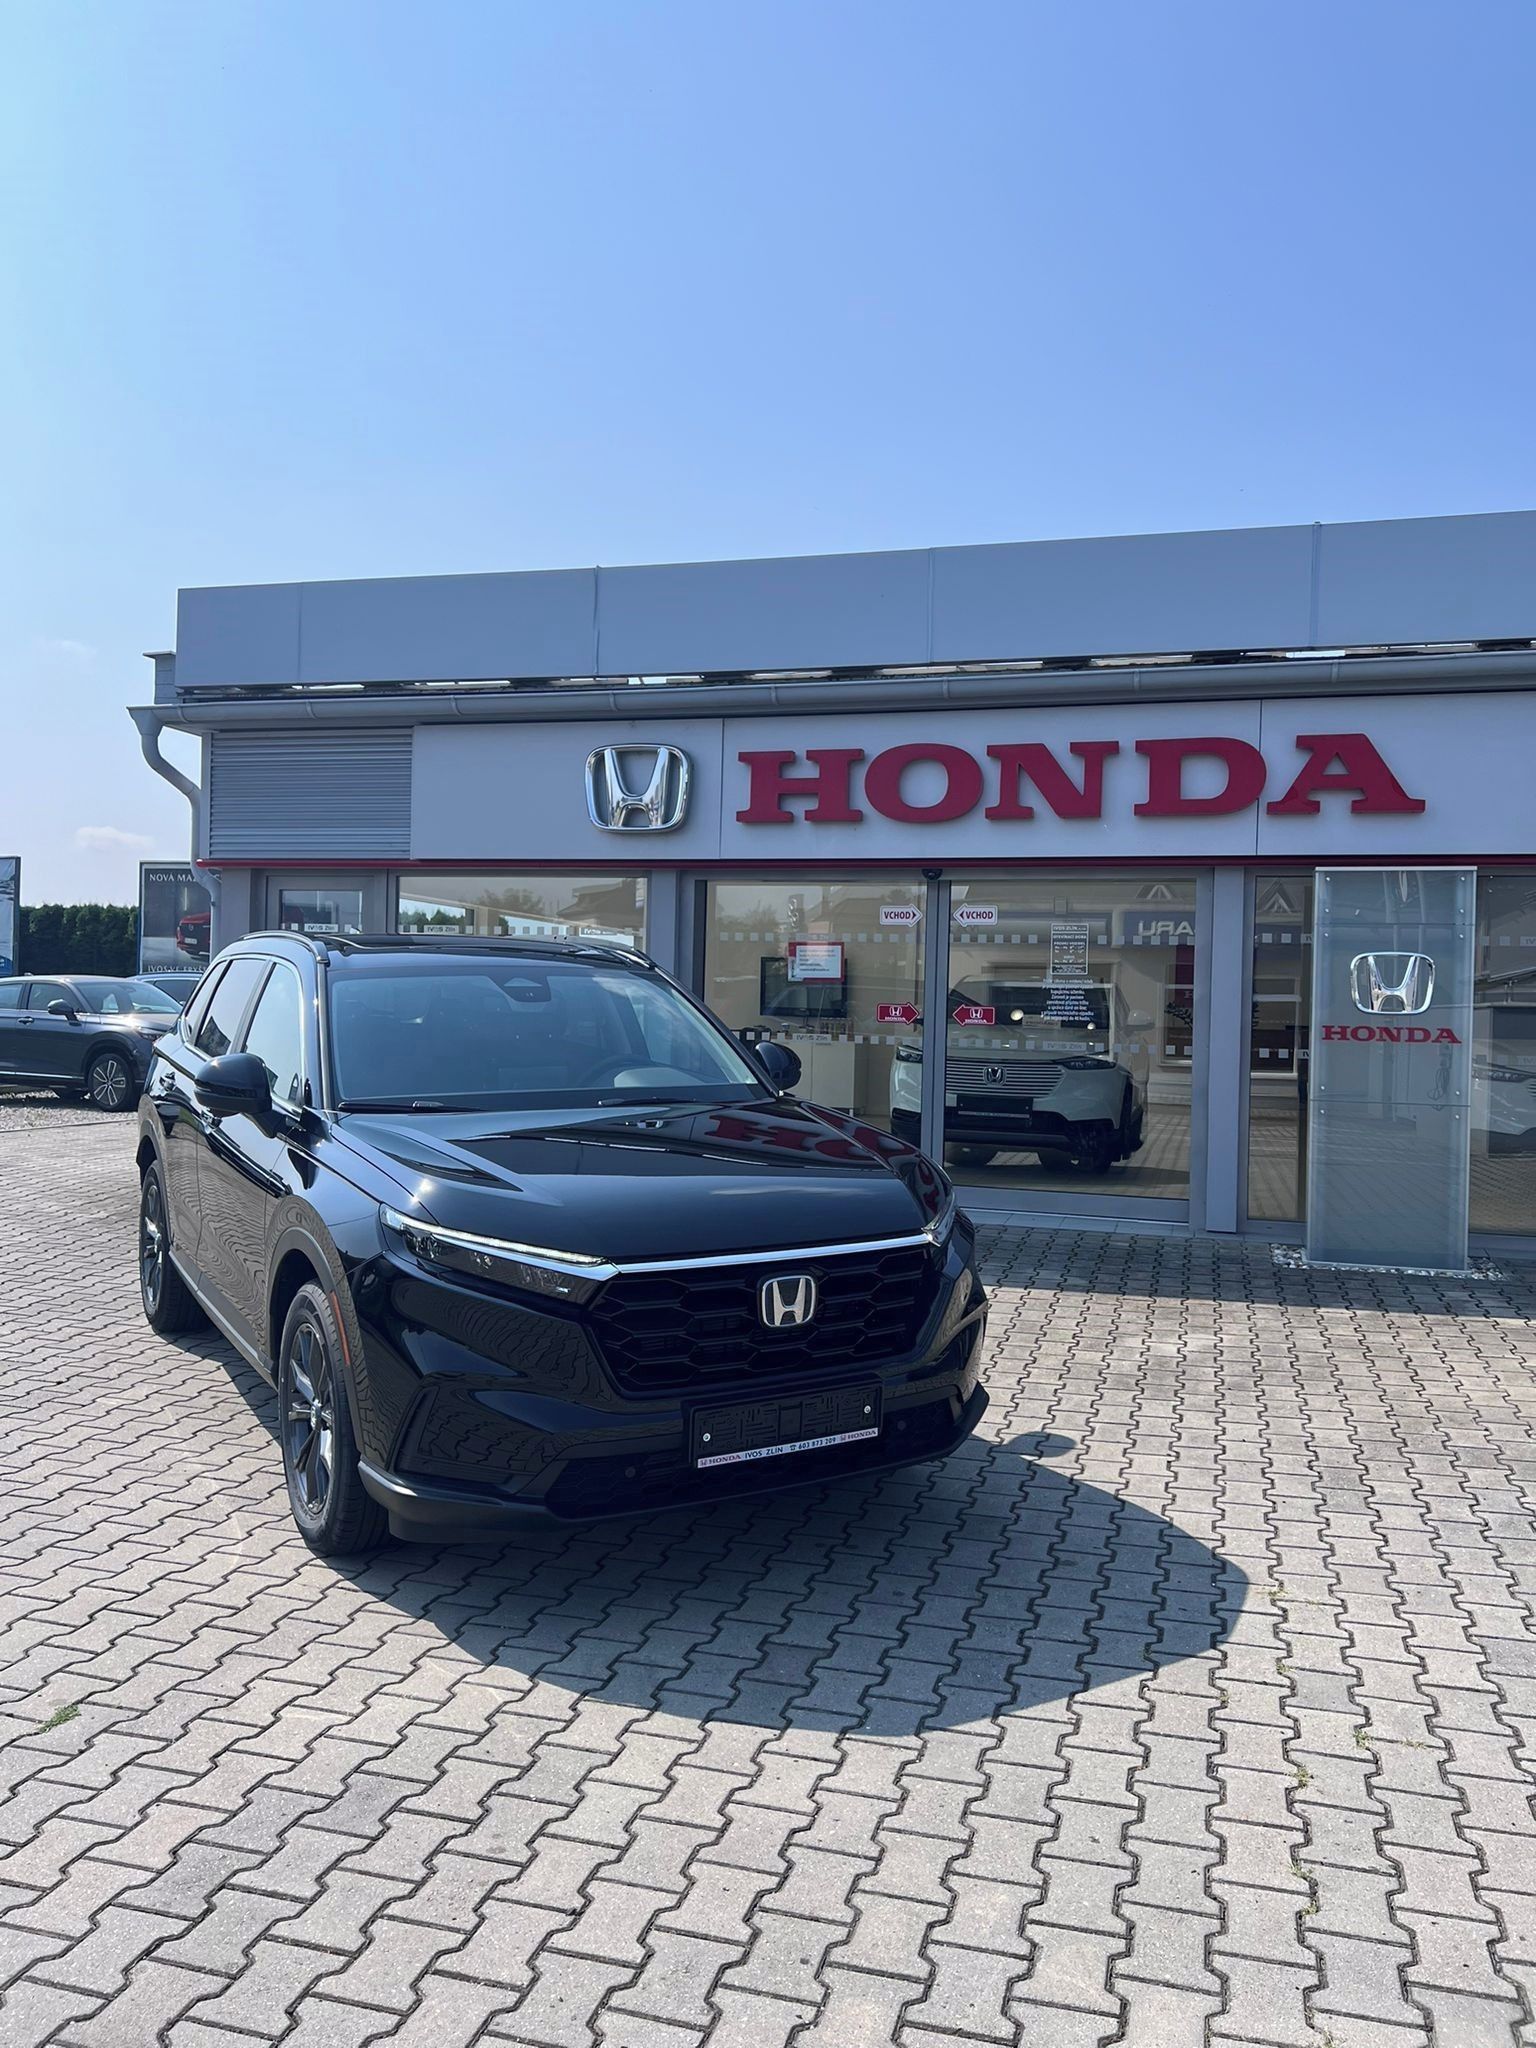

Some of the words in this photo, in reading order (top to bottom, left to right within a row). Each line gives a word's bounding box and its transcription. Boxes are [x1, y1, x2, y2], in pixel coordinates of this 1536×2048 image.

[735, 733, 1426, 825] HONDA
[149, 871, 175, 882] NOVÁ
[884, 911, 911, 920] VCHOD
[965, 910, 994, 920] VCHOD
[1321, 1024, 1462, 1044] HONDA
[708, 1454, 741, 1465] HONDA
[744, 1449, 763, 1459] IVOS
[798, 1442, 810, 1450] 603
[847, 1430, 877, 1440] HONDA
